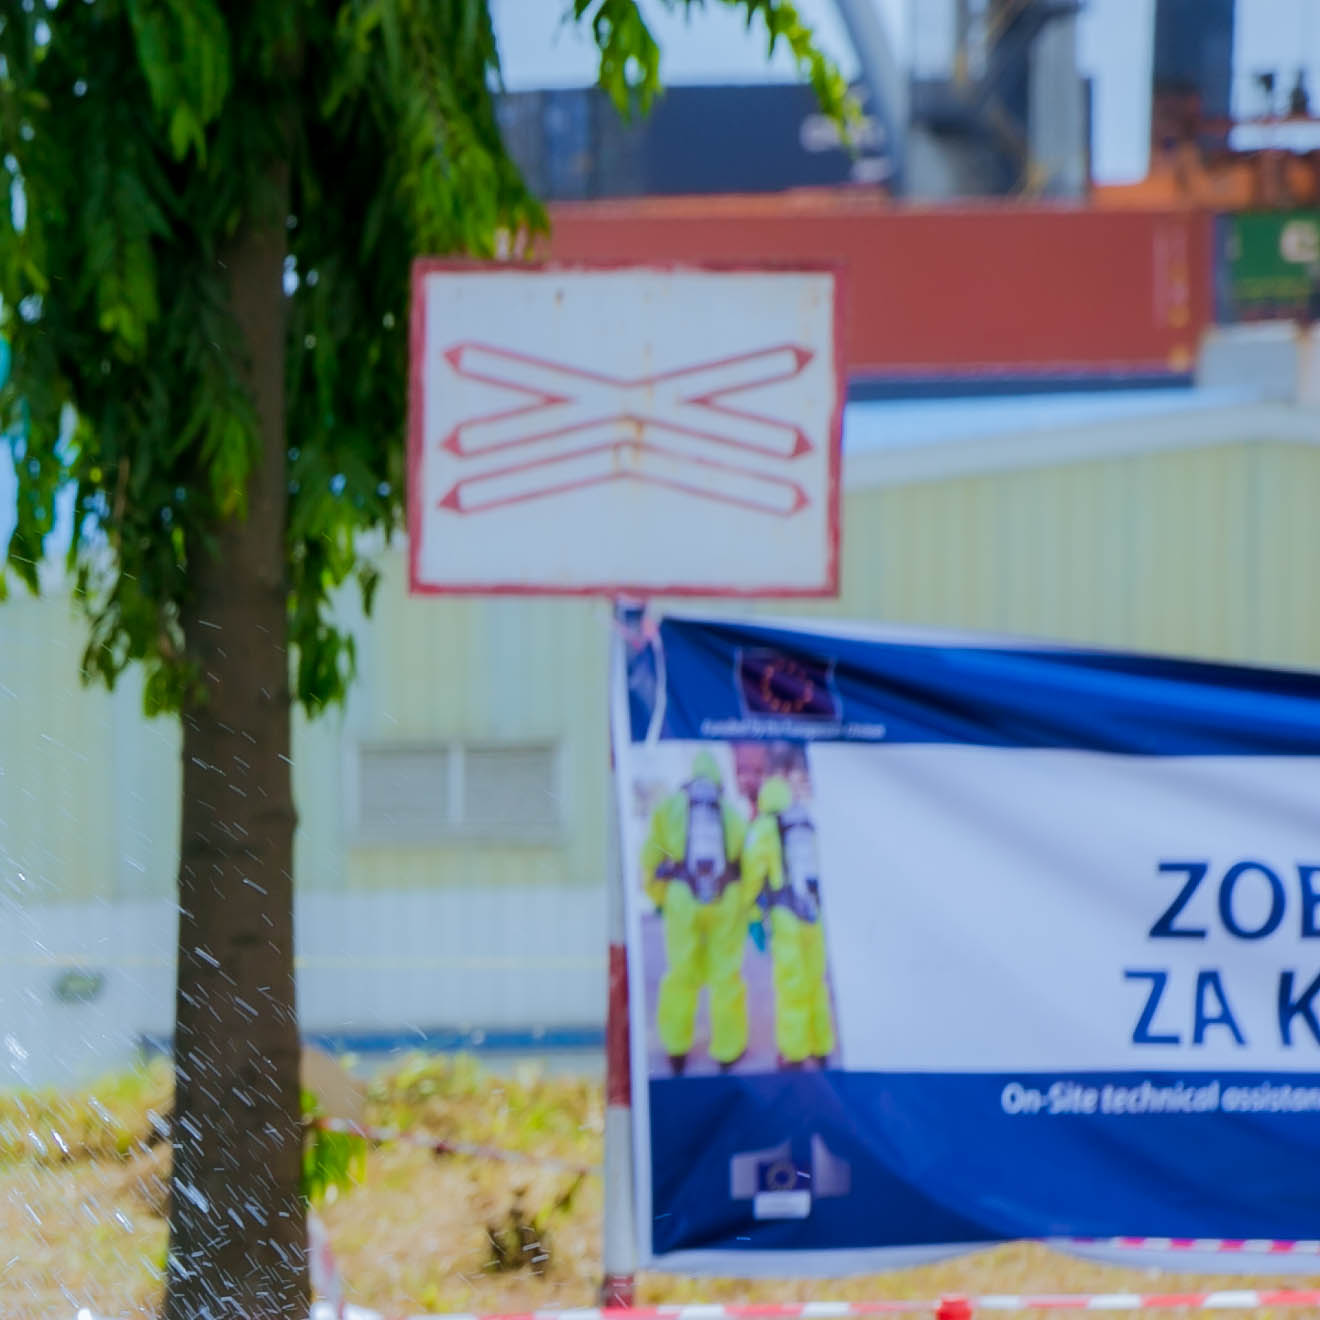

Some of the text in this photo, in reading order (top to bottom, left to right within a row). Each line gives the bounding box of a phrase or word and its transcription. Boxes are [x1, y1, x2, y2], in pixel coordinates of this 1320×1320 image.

[1124, 970, 1320, 1047] ZA K
[1001, 1080, 1098, 1115] On-Site
[1100, 1080, 1220, 1114] technical
